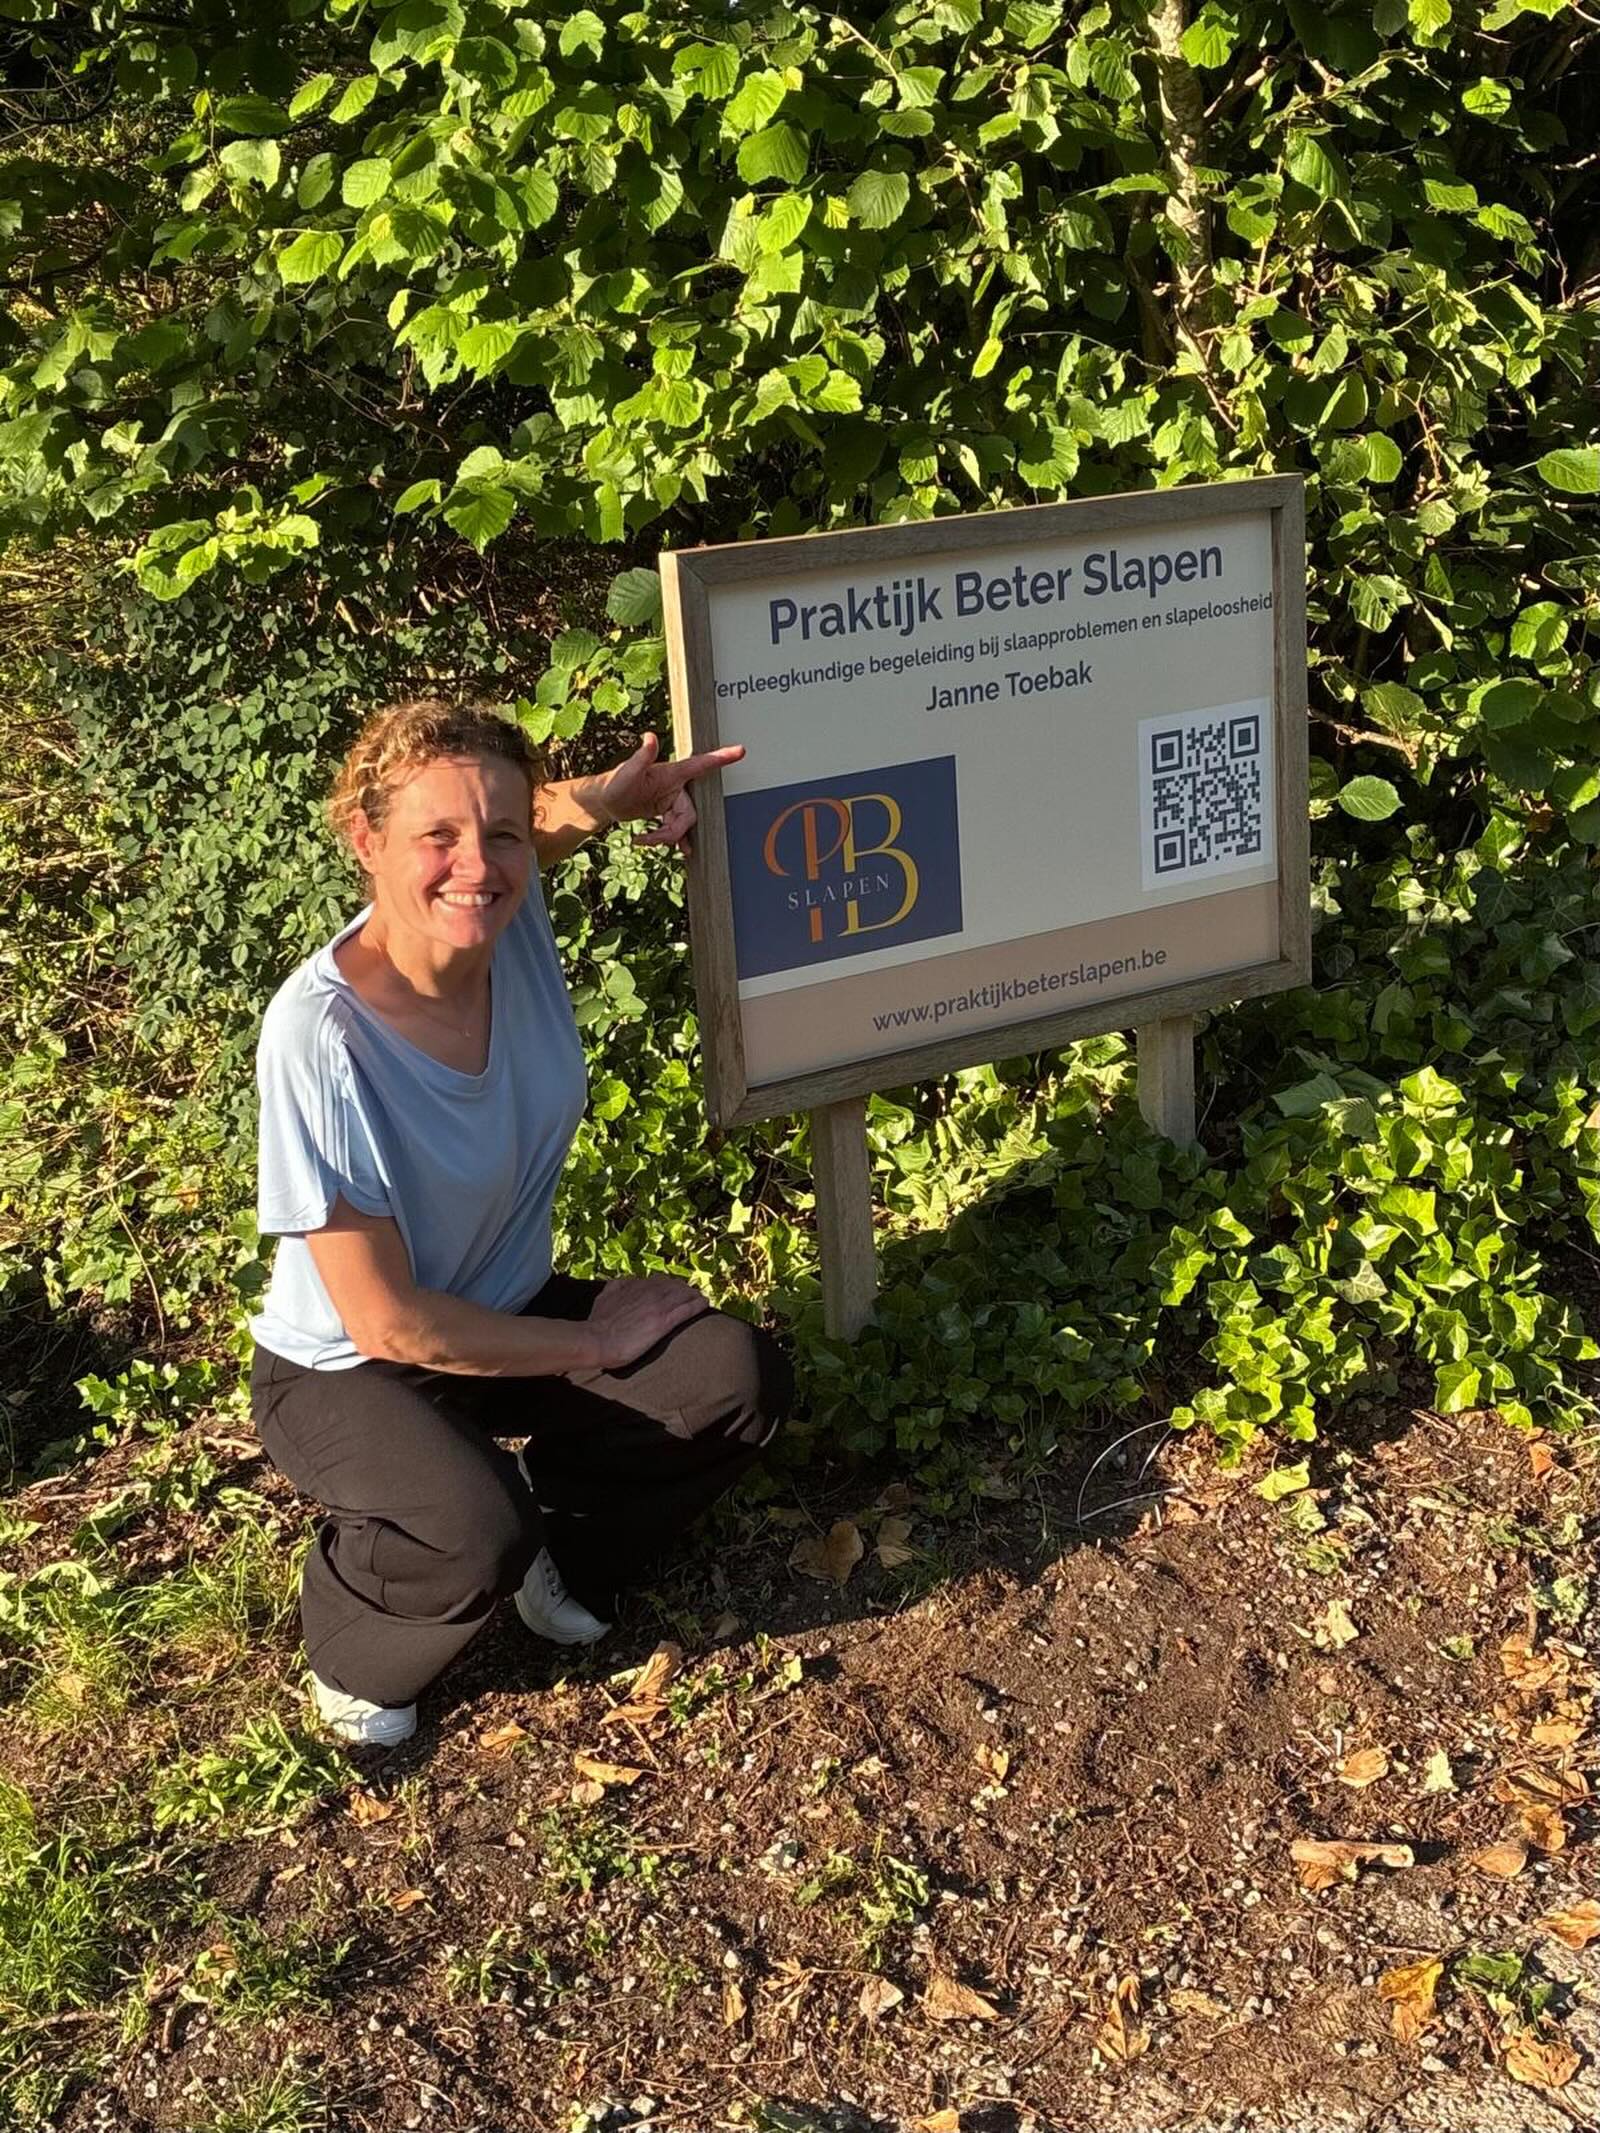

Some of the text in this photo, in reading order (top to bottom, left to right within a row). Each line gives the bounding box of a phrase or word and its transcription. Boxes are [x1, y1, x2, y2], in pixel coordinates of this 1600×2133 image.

[768, 545, 1223, 645] Praktijk Beter Slapen
[869, 641, 975, 674] begeleiding
[979, 636, 1001, 658] bij
[1003, 615, 1138, 652] slaapproblemen
[1142, 614, 1162, 630] en
[1165, 591, 1273, 626] slapeloosheid
[925, 660, 1093, 711] Janne Toebak
[787, 872, 890, 910] SLAPEN
[872, 949, 1167, 1032] www.praktijkbeterslapen.be
